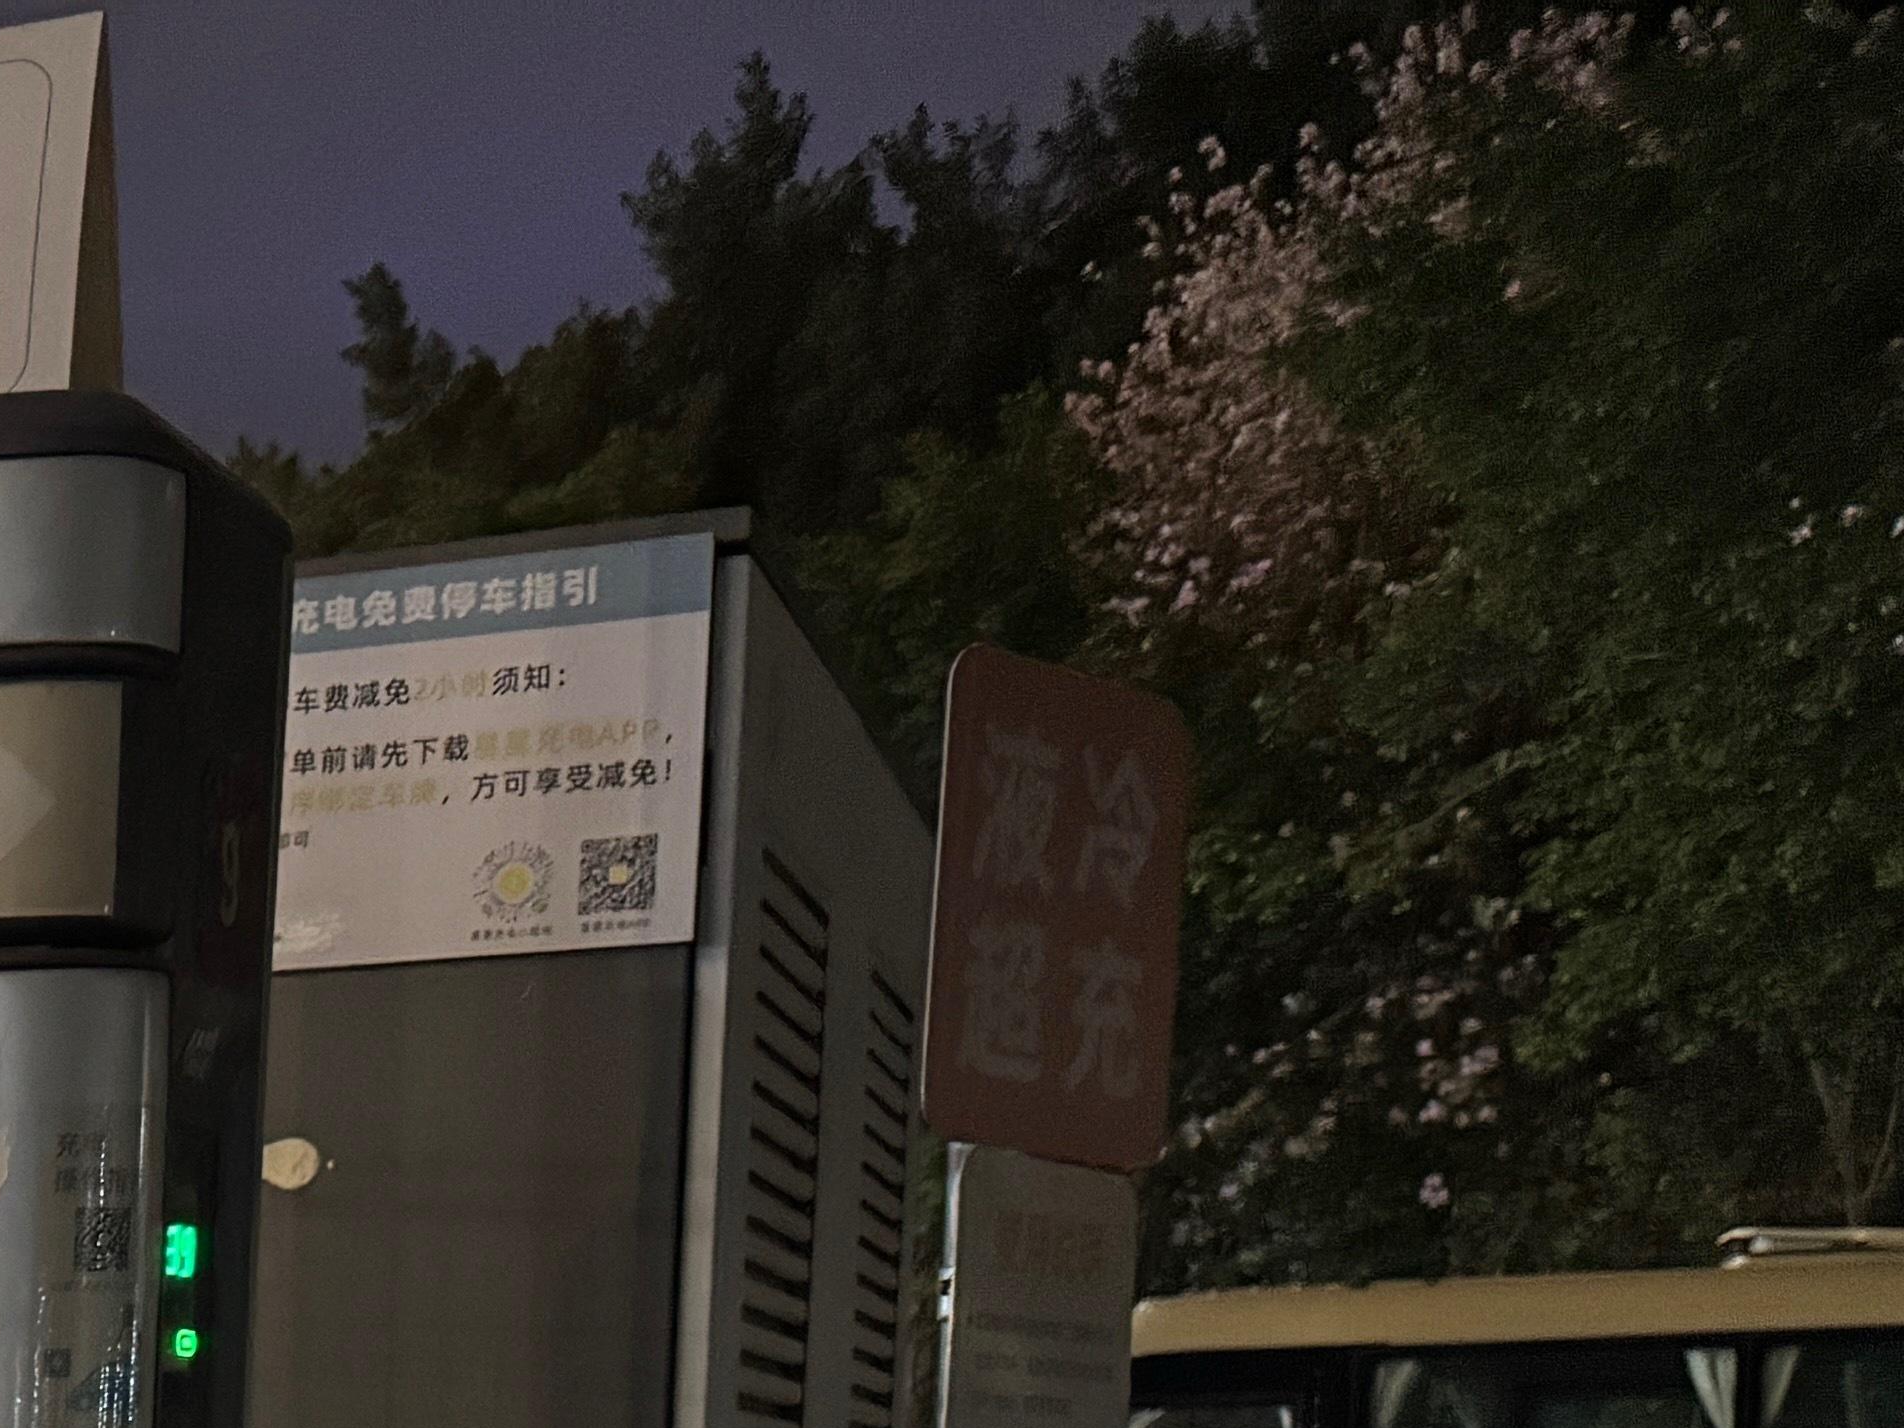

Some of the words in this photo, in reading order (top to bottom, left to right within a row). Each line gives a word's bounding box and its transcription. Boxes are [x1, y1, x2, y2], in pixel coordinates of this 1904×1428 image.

[291, 565, 598, 634] 充电免费停车指引
